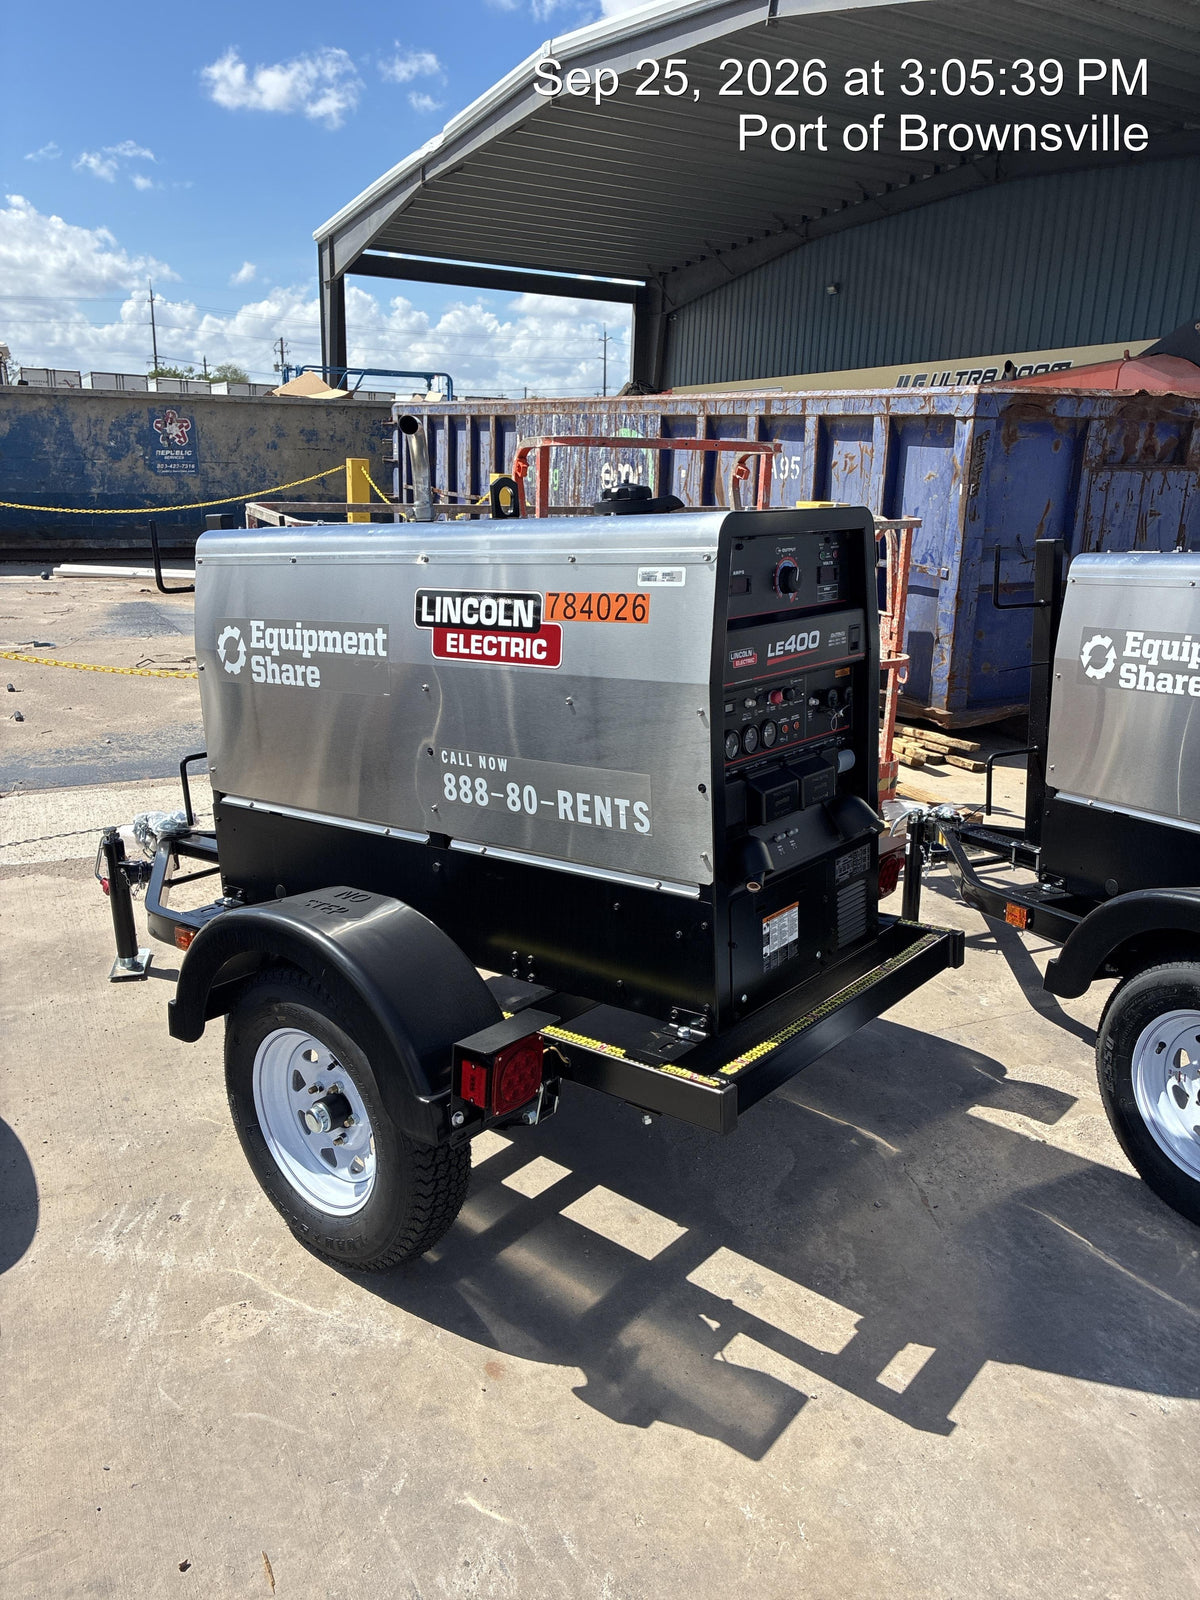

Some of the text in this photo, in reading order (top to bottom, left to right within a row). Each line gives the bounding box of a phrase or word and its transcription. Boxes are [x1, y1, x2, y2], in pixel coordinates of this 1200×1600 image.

[930, 368, 998, 386] ULTRA
[1001, 362, 1073, 380] OOM
[420, 595, 534, 628] LINCOLN
[548, 592, 647, 622] 784026
[250, 620, 388, 659] Equipment
[446, 632, 548, 660] ELECTRIC
[767, 630, 820, 658] LE400
[730, 649, 753, 660] LINCOLN
[735, 657, 755, 667] ELECTRIC
[250, 654, 321, 688] Share
[1118, 662, 1200, 698] Share
[441, 750, 508, 772] CALL NOW
[443, 772, 651, 834] 888-80-RENTS
[304, 899, 350, 915] STEP
[333, 890, 372, 903] NO
